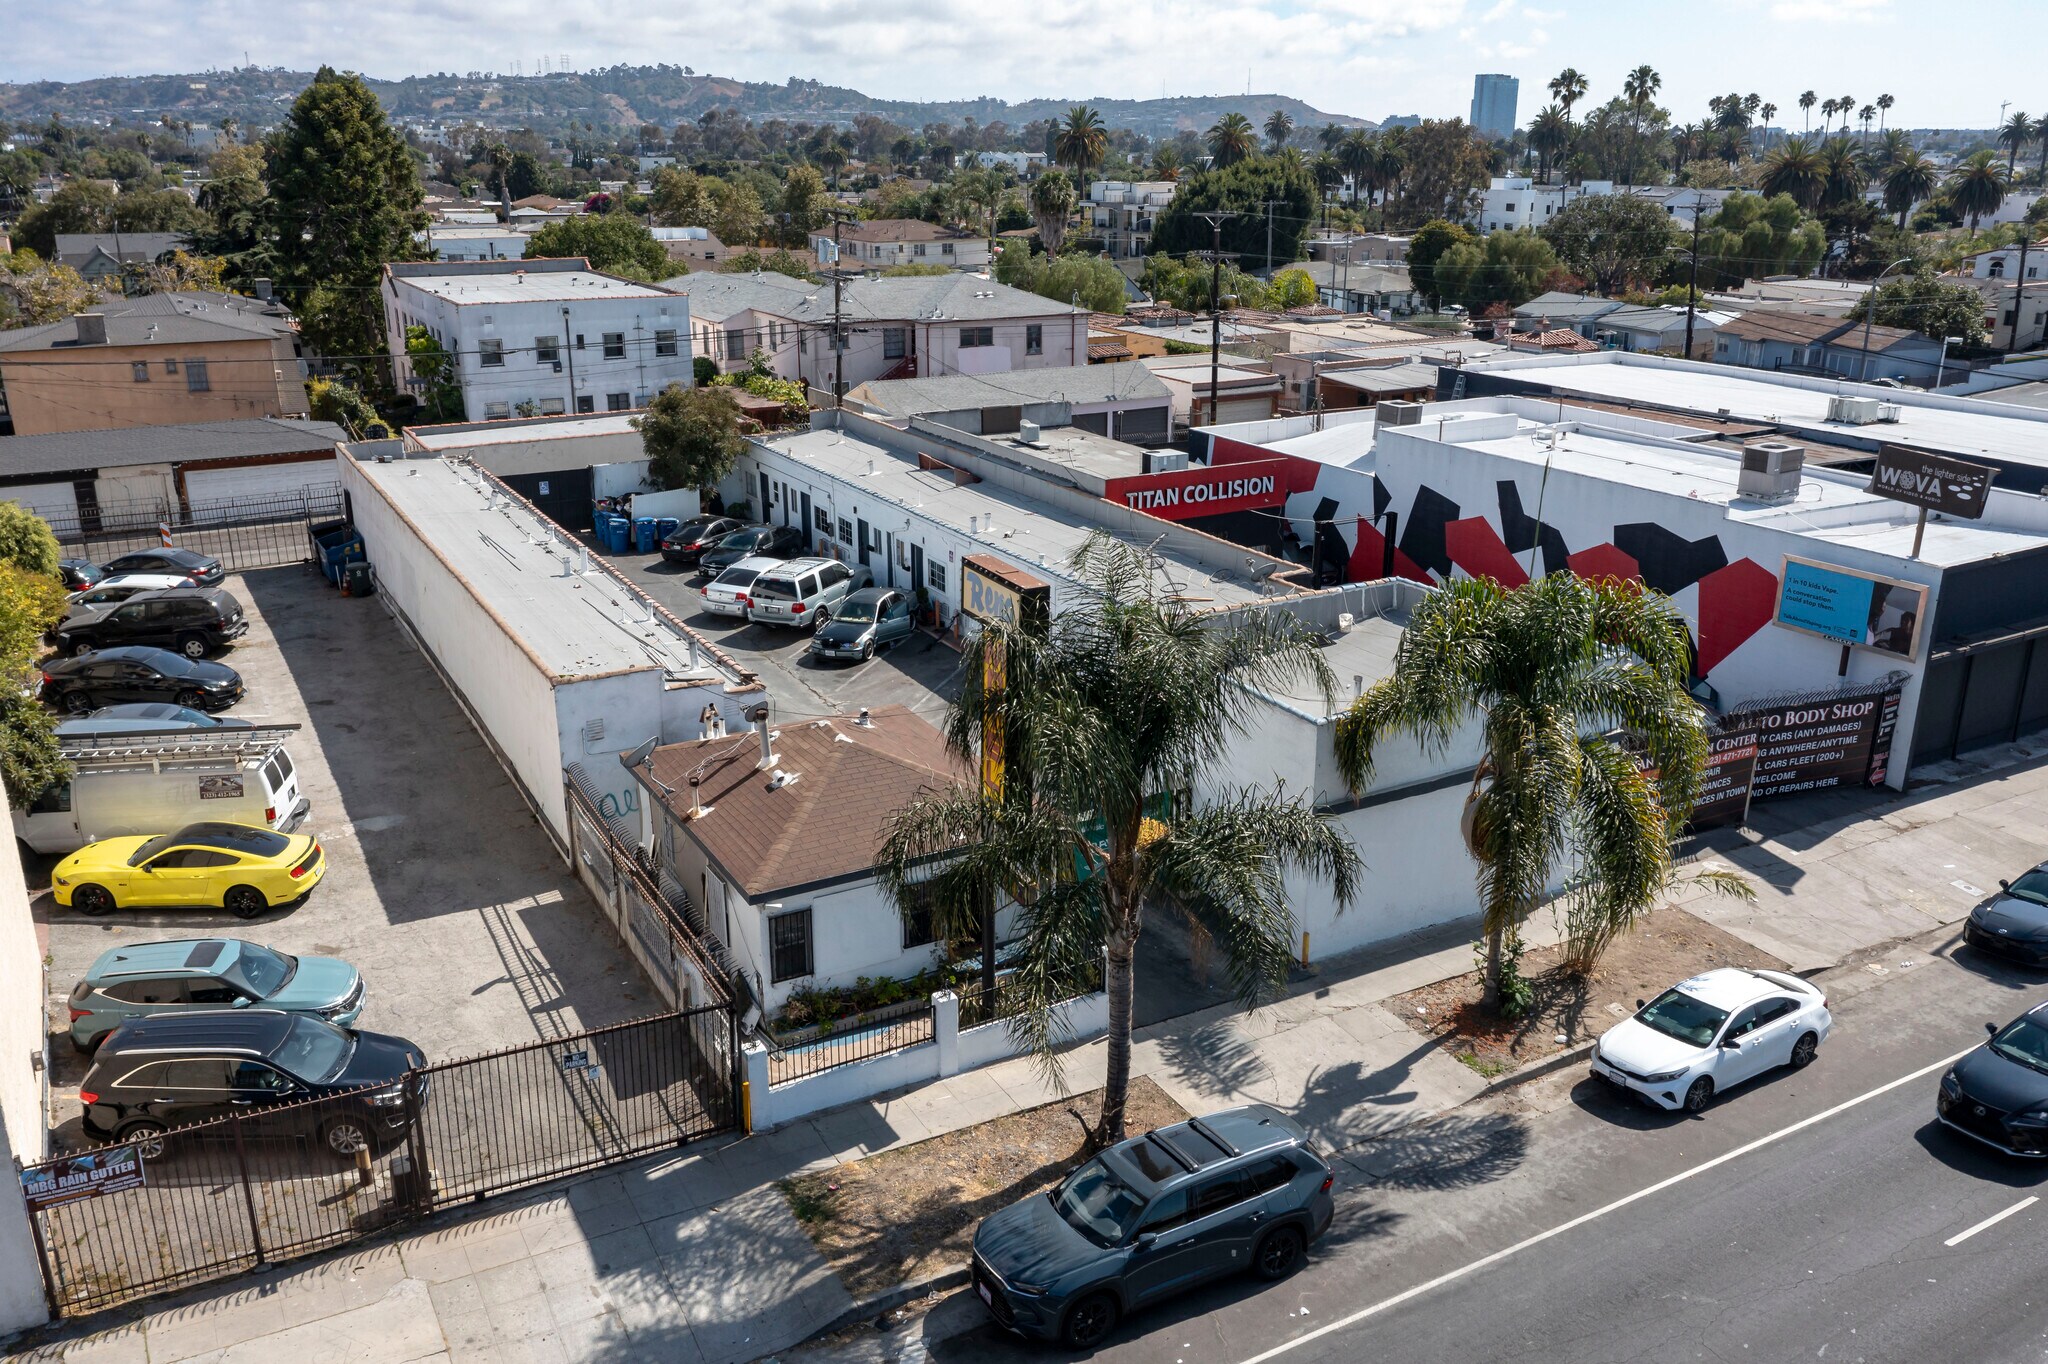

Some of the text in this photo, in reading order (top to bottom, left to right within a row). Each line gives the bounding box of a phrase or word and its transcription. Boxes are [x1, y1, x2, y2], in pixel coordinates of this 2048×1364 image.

[1881, 465, 1941, 497] WOVA
[1922, 465, 1971, 483] the lighter side
[1126, 476, 1274, 510] TITAN COLLISION
[1793, 589, 1831, 603] conversation
[1809, 582, 1820, 590] kids
[1822, 585, 1838, 594] Vape.
[1818, 603, 1836, 611] them.
[1785, 707, 1829, 726] BODY
[1832, 702, 1874, 719] SHOP
[1769, 731, 1792, 742] CARS
[1794, 728, 1817, 739] (ANY
[1817, 721, 1861, 735] DAMAGES)
[1716, 734, 1757, 751] CENTER
[1769, 735, 1858, 756] ANYWHERE/ANYTIME
[1723, 748, 1753, 761] 471-7721
[1765, 759, 1787, 770] CARS
[1789, 755, 1815, 766] FLEET
[1816, 750, 1844, 762] (200+)
[1752, 771, 1796, 784] WELCOME
[1765, 786, 1778, 795] OF
[1779, 781, 1814, 793] REPAIRS
[1816, 777, 1839, 787] HERE
[1716, 791, 1725, 799] IN
[1726, 785, 1747, 798] TOWN
[566, 1059, 586, 1067] PARKING
[27, 1179, 56, 1194] MBG
[58, 1172, 88, 1187] RAIN
[90, 1160, 135, 1180] GUTTER
